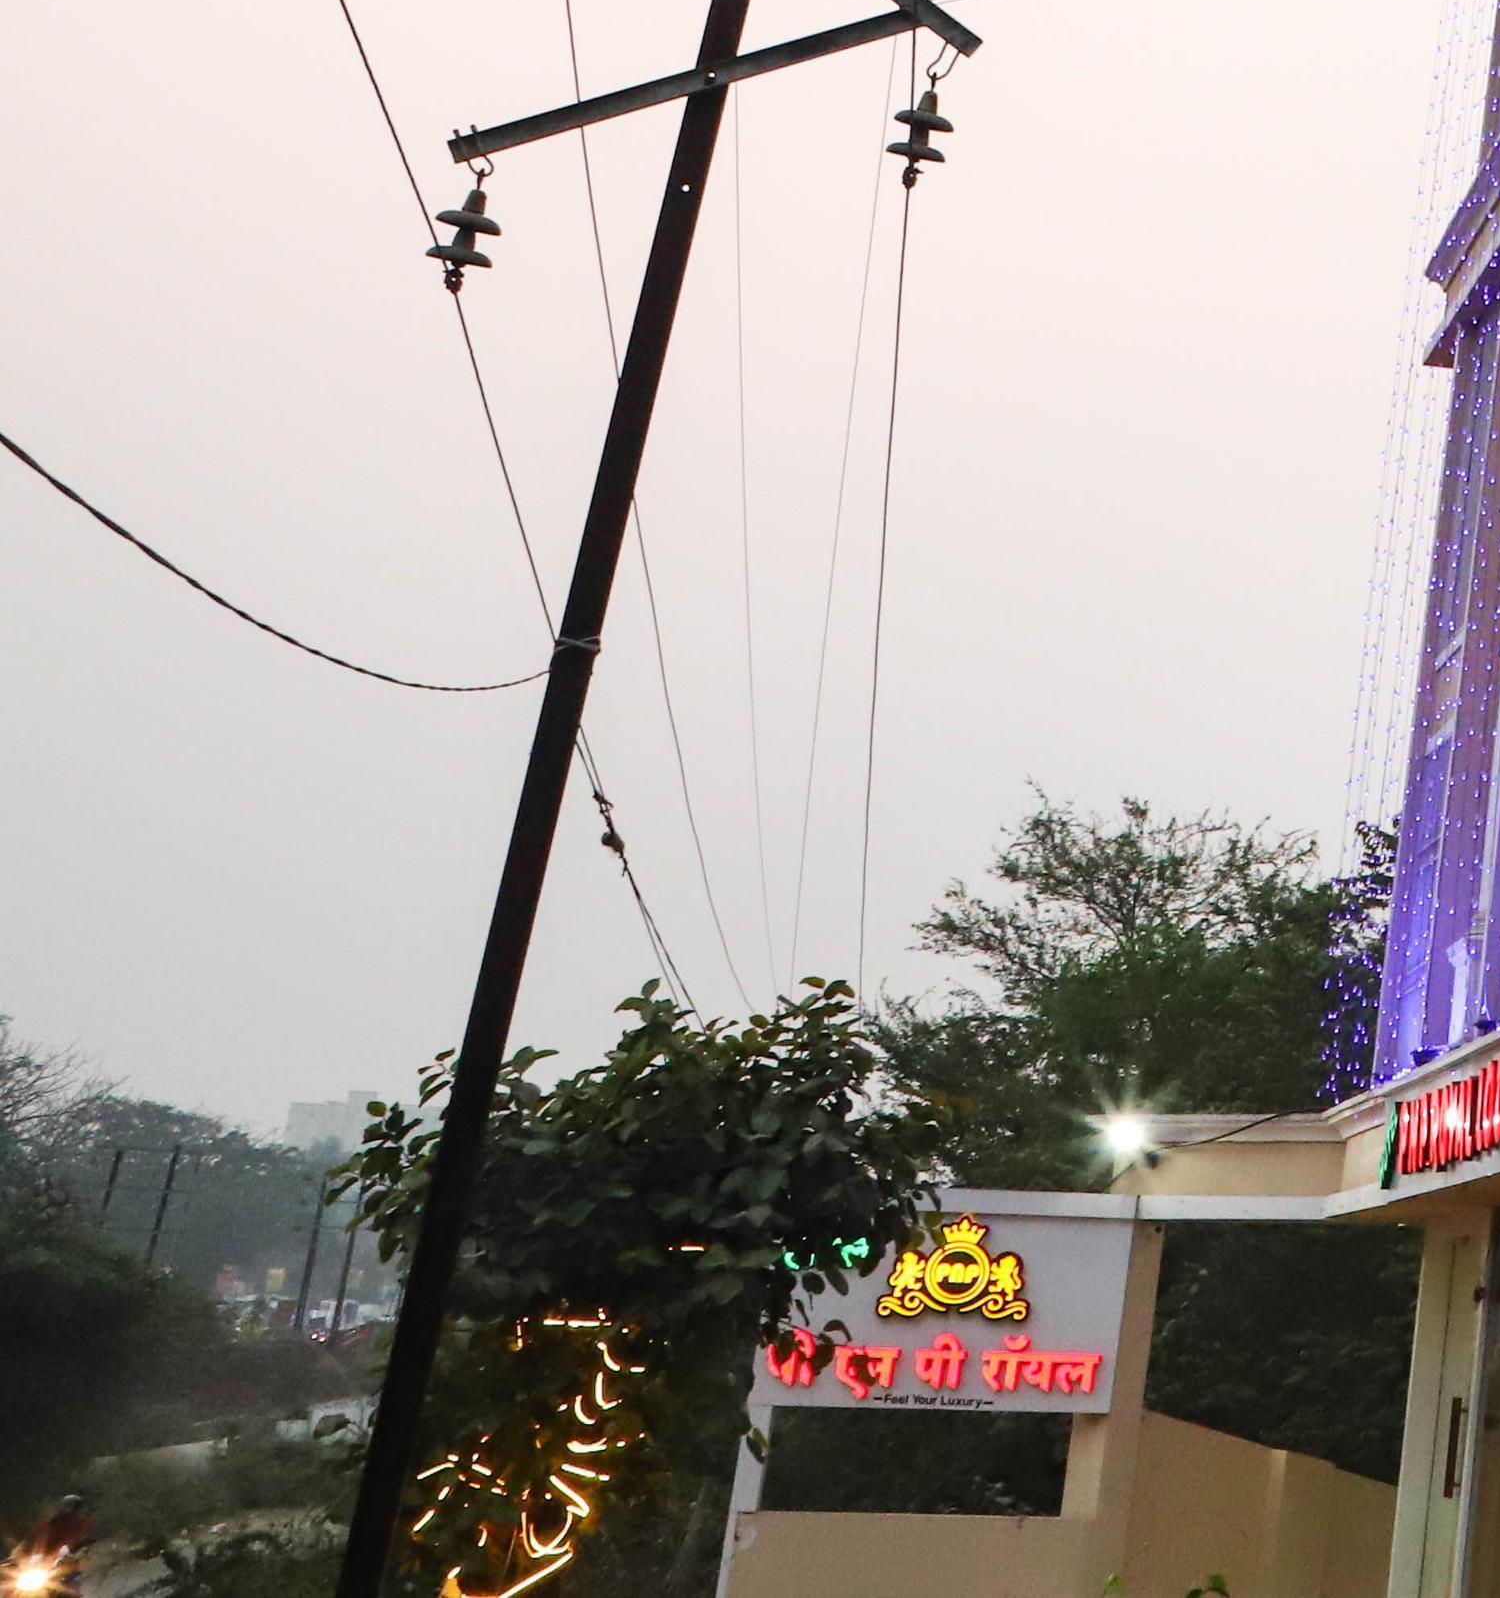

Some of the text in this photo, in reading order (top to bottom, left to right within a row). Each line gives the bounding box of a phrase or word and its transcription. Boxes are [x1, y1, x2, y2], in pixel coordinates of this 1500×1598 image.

[913, 1331, 969, 1392] पी
[980, 1332, 1104, 1395] रॉयल
[912, 1394, 938, 1405] Your
[940, 1395, 983, 1408] Luxury
